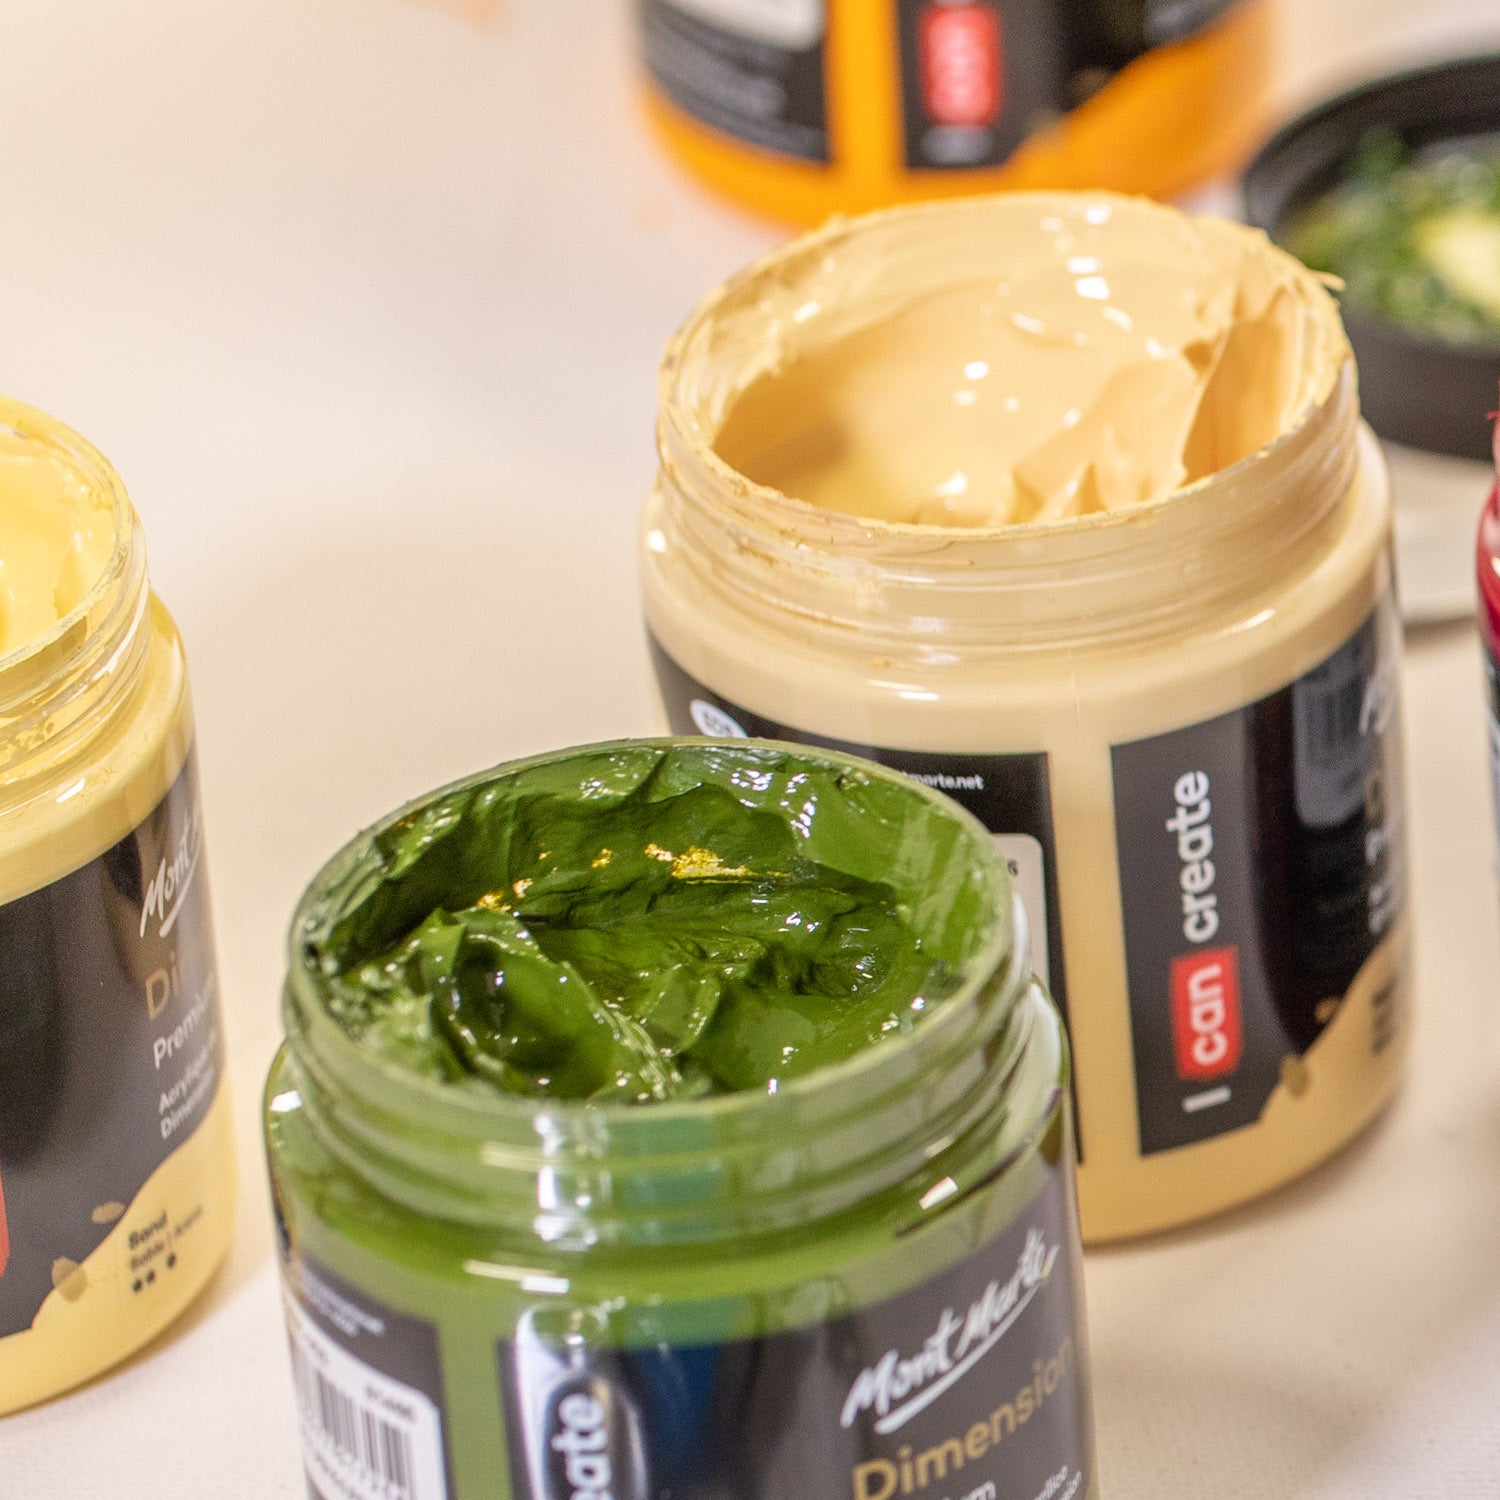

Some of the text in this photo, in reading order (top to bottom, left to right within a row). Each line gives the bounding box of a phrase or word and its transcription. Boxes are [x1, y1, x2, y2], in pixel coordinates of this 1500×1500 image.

[1166, 770, 1232, 1114] I can create
[839, 1225, 1061, 1429] Mont Marte
